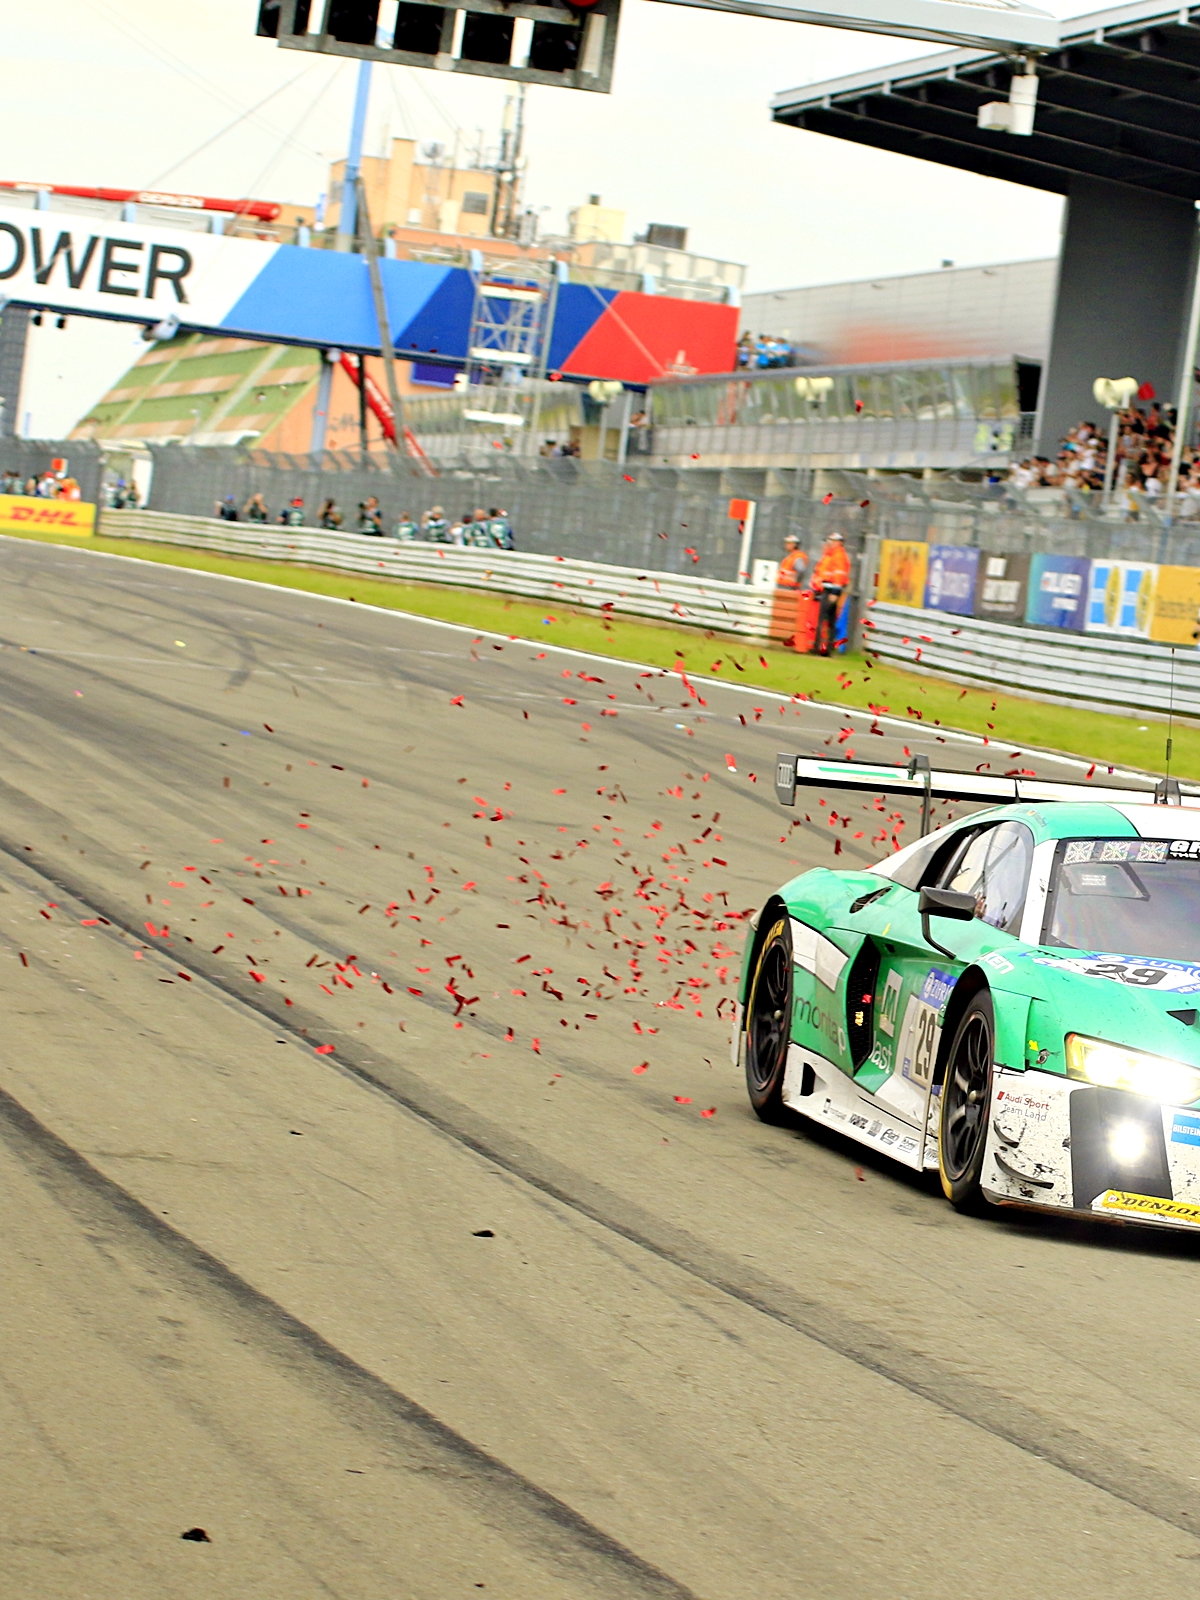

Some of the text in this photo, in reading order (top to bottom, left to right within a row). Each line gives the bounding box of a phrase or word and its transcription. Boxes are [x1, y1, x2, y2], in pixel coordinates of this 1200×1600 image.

[10, 506, 77, 526] DHL
[1084, 964, 1168, 985] 29
[914, 1008, 936, 1080] 29
[1005, 1093, 1049, 1111] Audi Sport
[1003, 1104, 1047, 1121] Team Land
